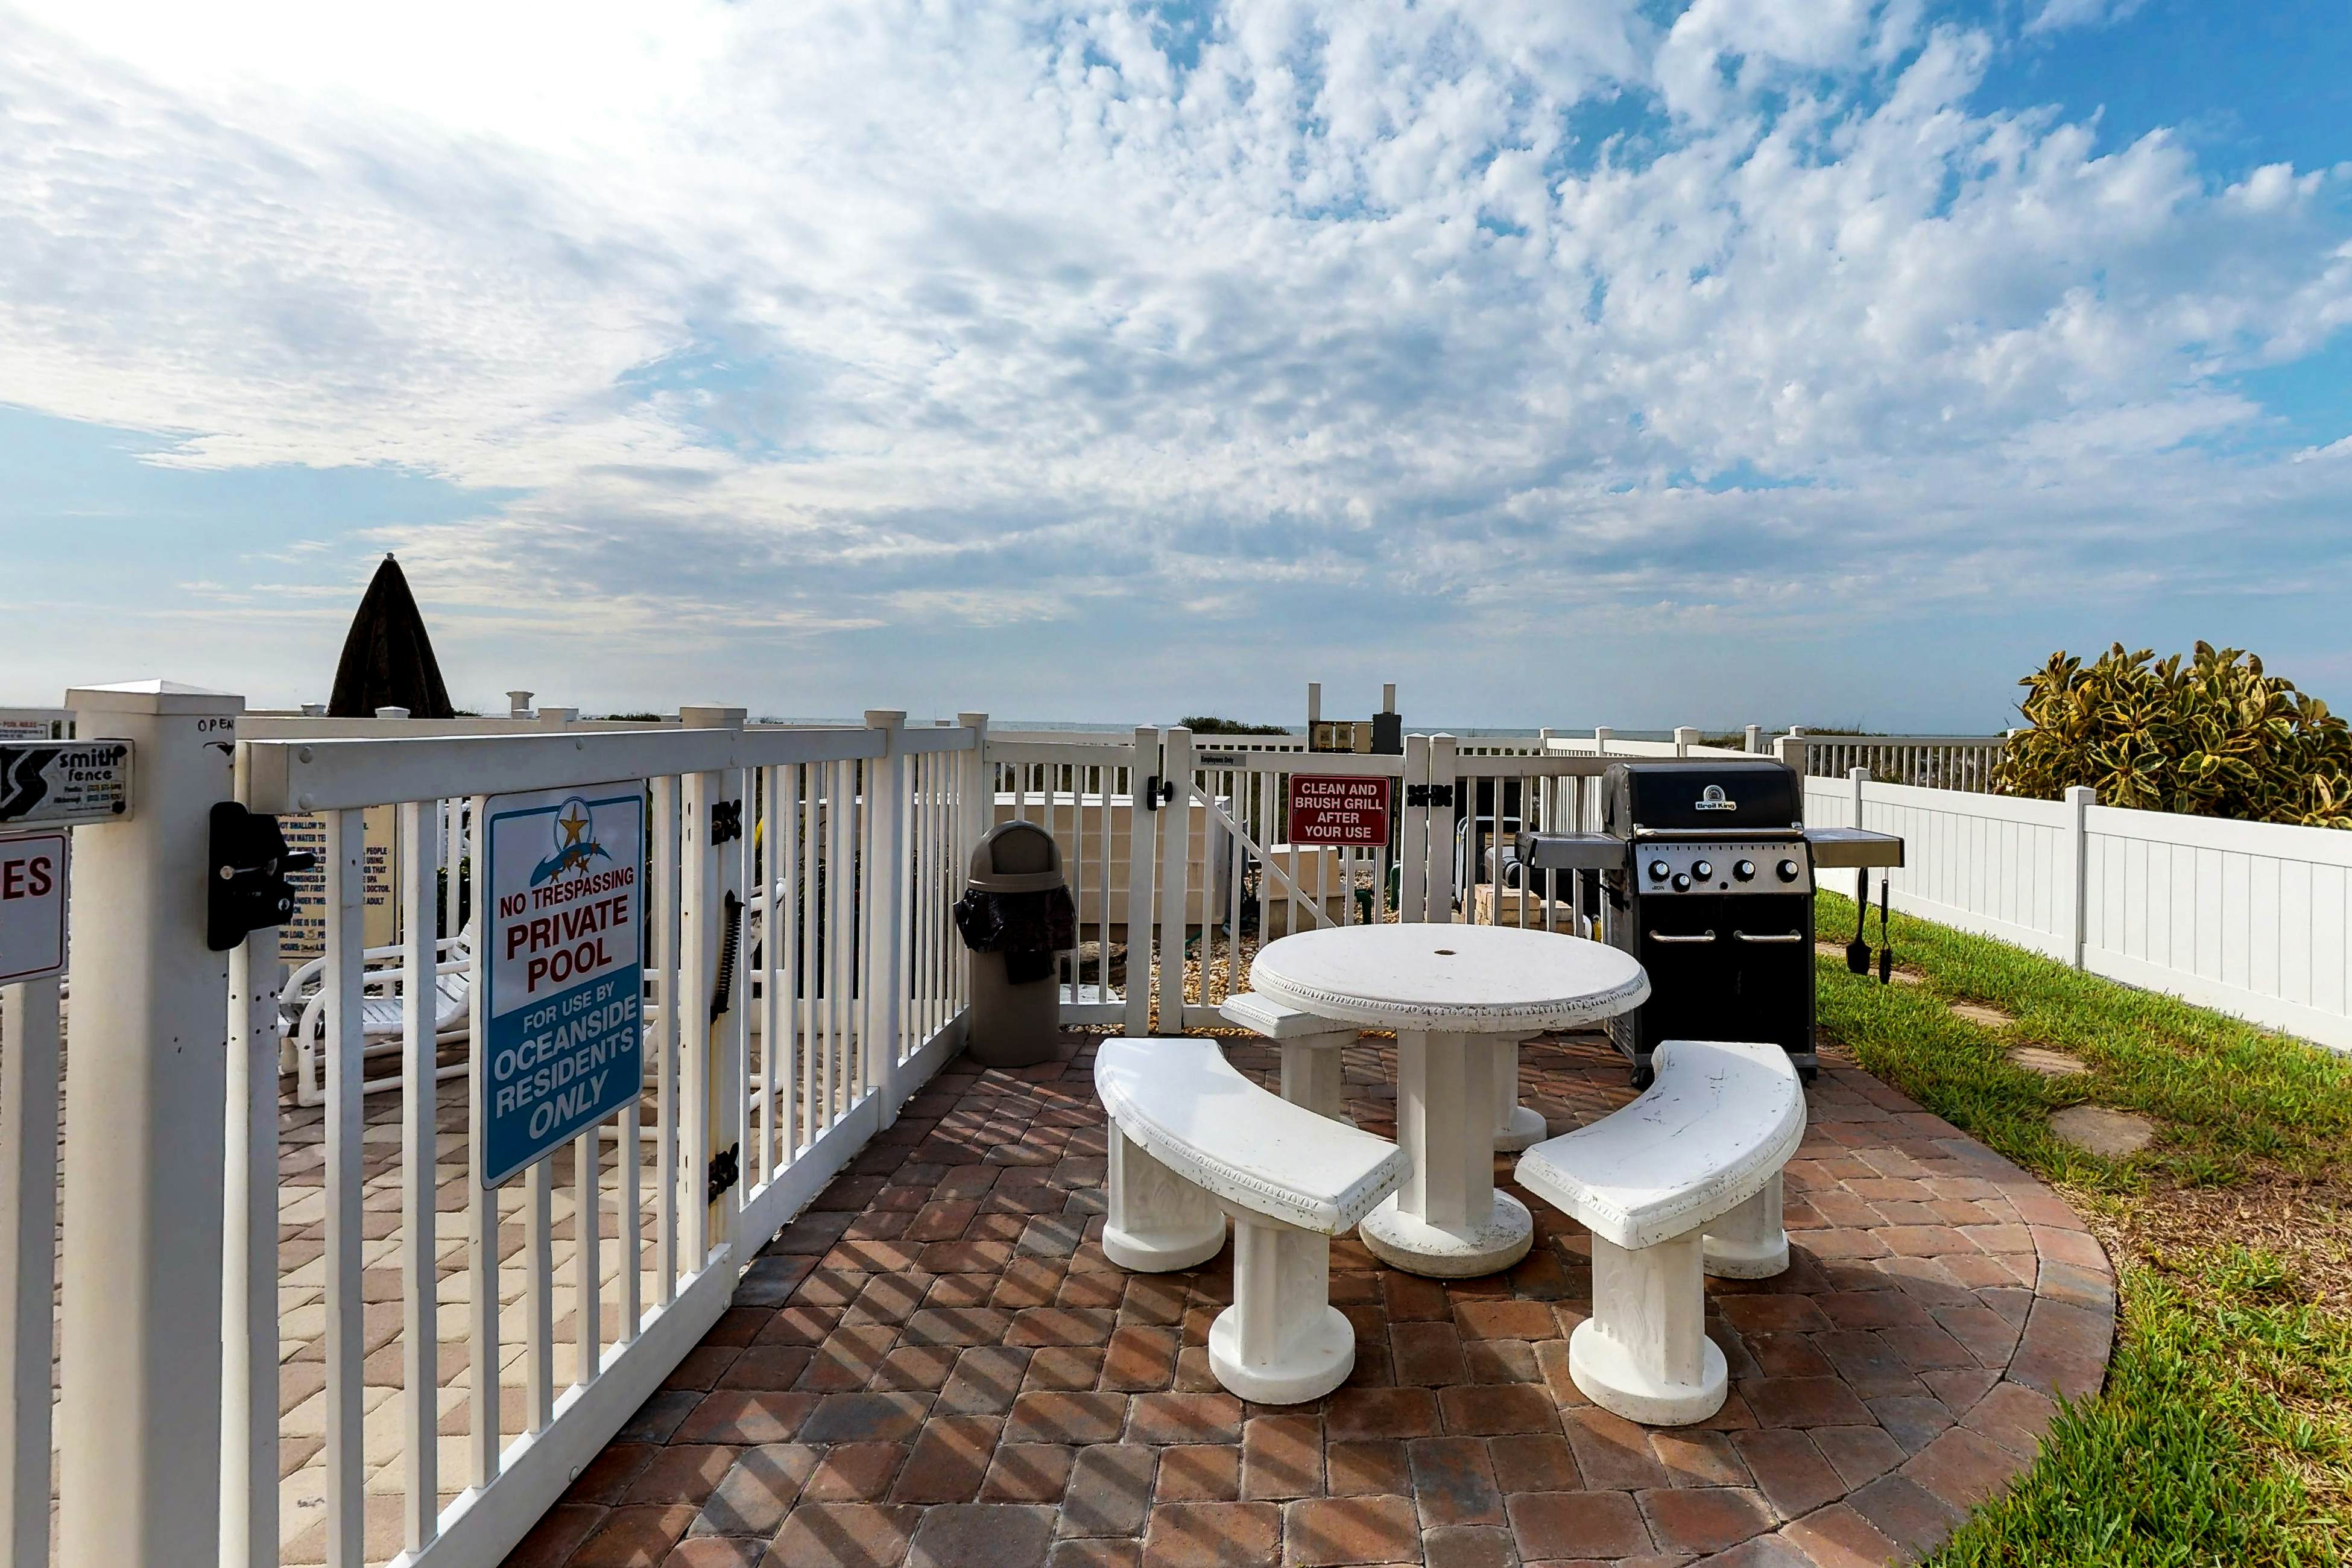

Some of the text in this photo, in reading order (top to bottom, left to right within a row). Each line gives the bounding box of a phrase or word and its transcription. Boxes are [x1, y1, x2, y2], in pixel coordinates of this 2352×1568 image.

[197, 718, 235, 732] OPEN
[59, 748, 118, 768] smith
[1201, 756, 1234, 765] Employees Only
[68, 769, 113, 782] fence
[1301, 783, 1377, 795] CLEAN AND
[1295, 797, 1383, 810] BRUSH GRILL
[1317, 812, 1359, 824] AFTER
[1305, 826, 1371, 838] YOUR USE
[499, 867, 634, 919] NO TRESPASSING
[507, 894, 628, 961] PRIVATE
[528, 937, 612, 993] POOL
[523, 981, 615, 1034] FOR USE BY
[494, 994, 637, 1081] OCEANSIDE
[496, 1026, 634, 1119] RESIDENTS
[528, 1069, 609, 1140] ONLY
